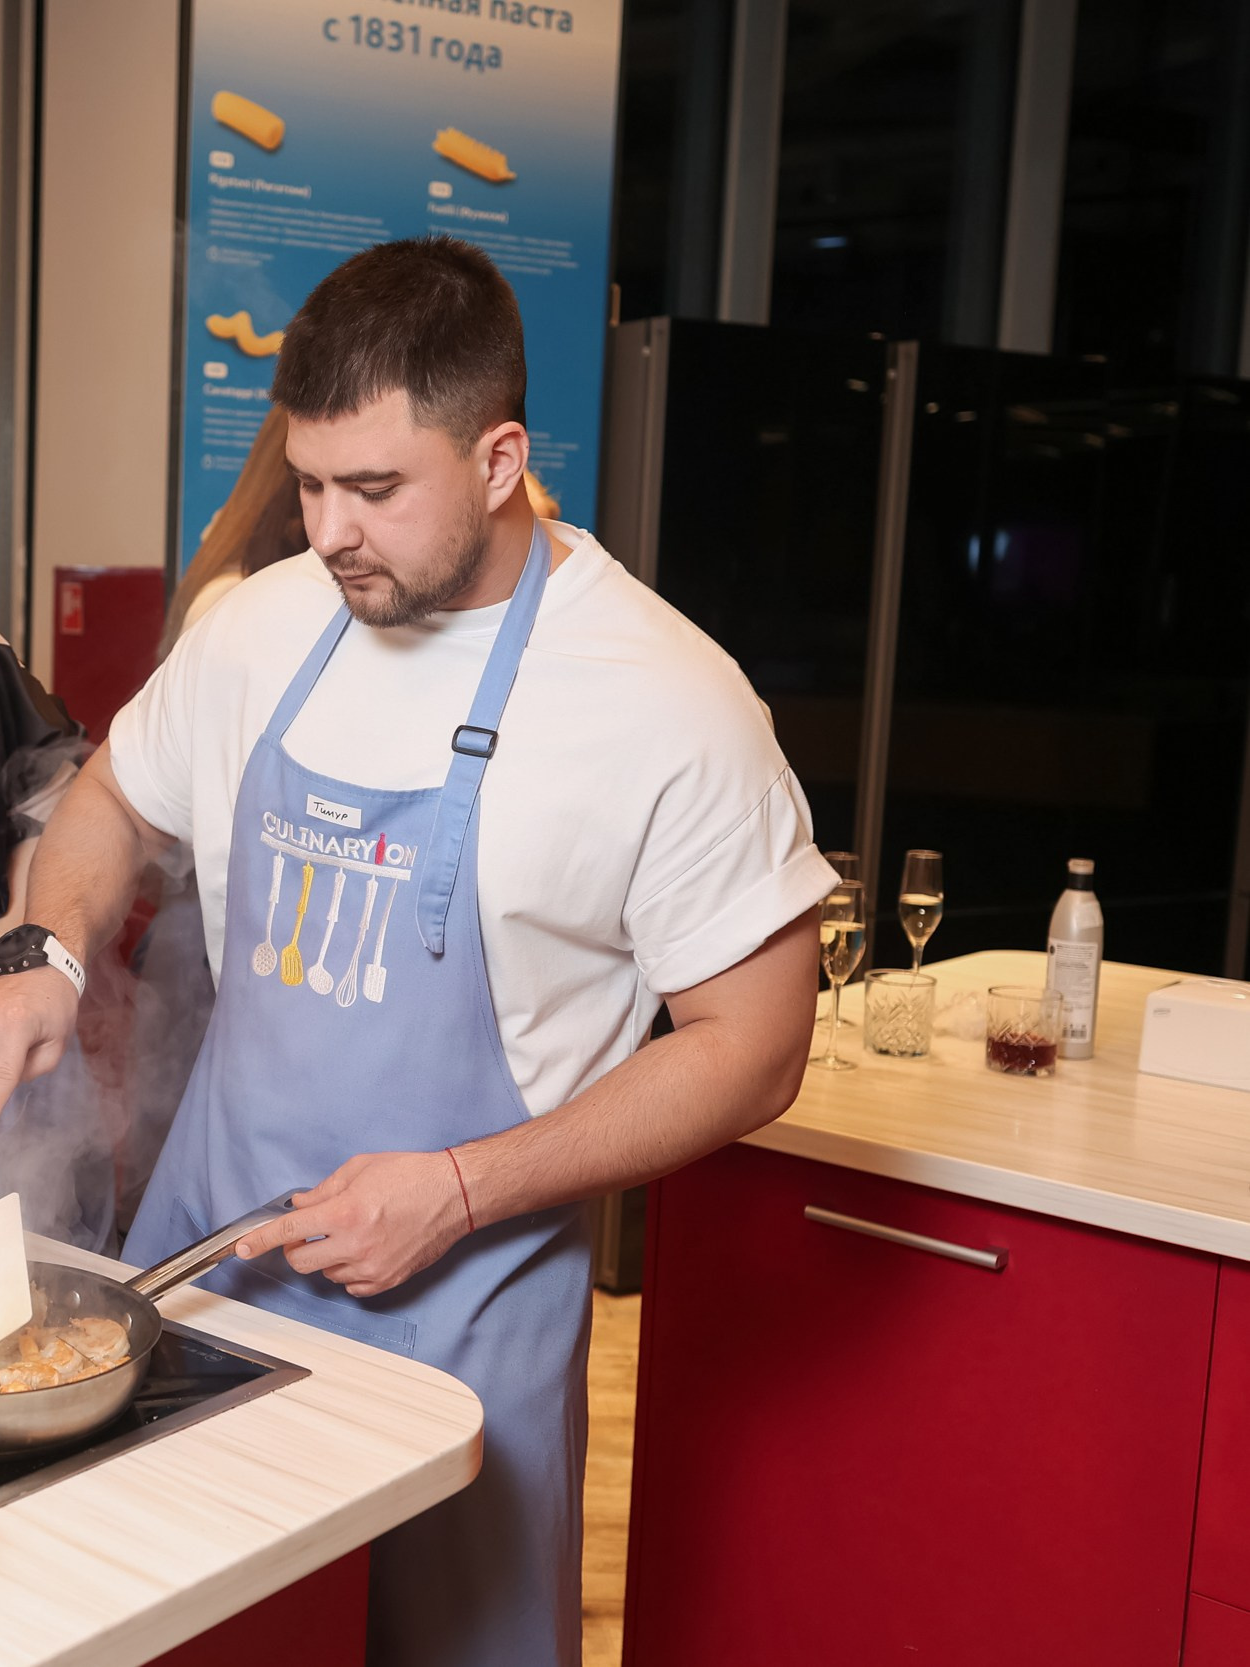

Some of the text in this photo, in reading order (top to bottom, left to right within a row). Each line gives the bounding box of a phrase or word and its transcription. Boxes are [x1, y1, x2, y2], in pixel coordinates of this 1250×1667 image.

[489, 0, 574, 34] паста
[322, 14, 504, 73] с 1831 года
